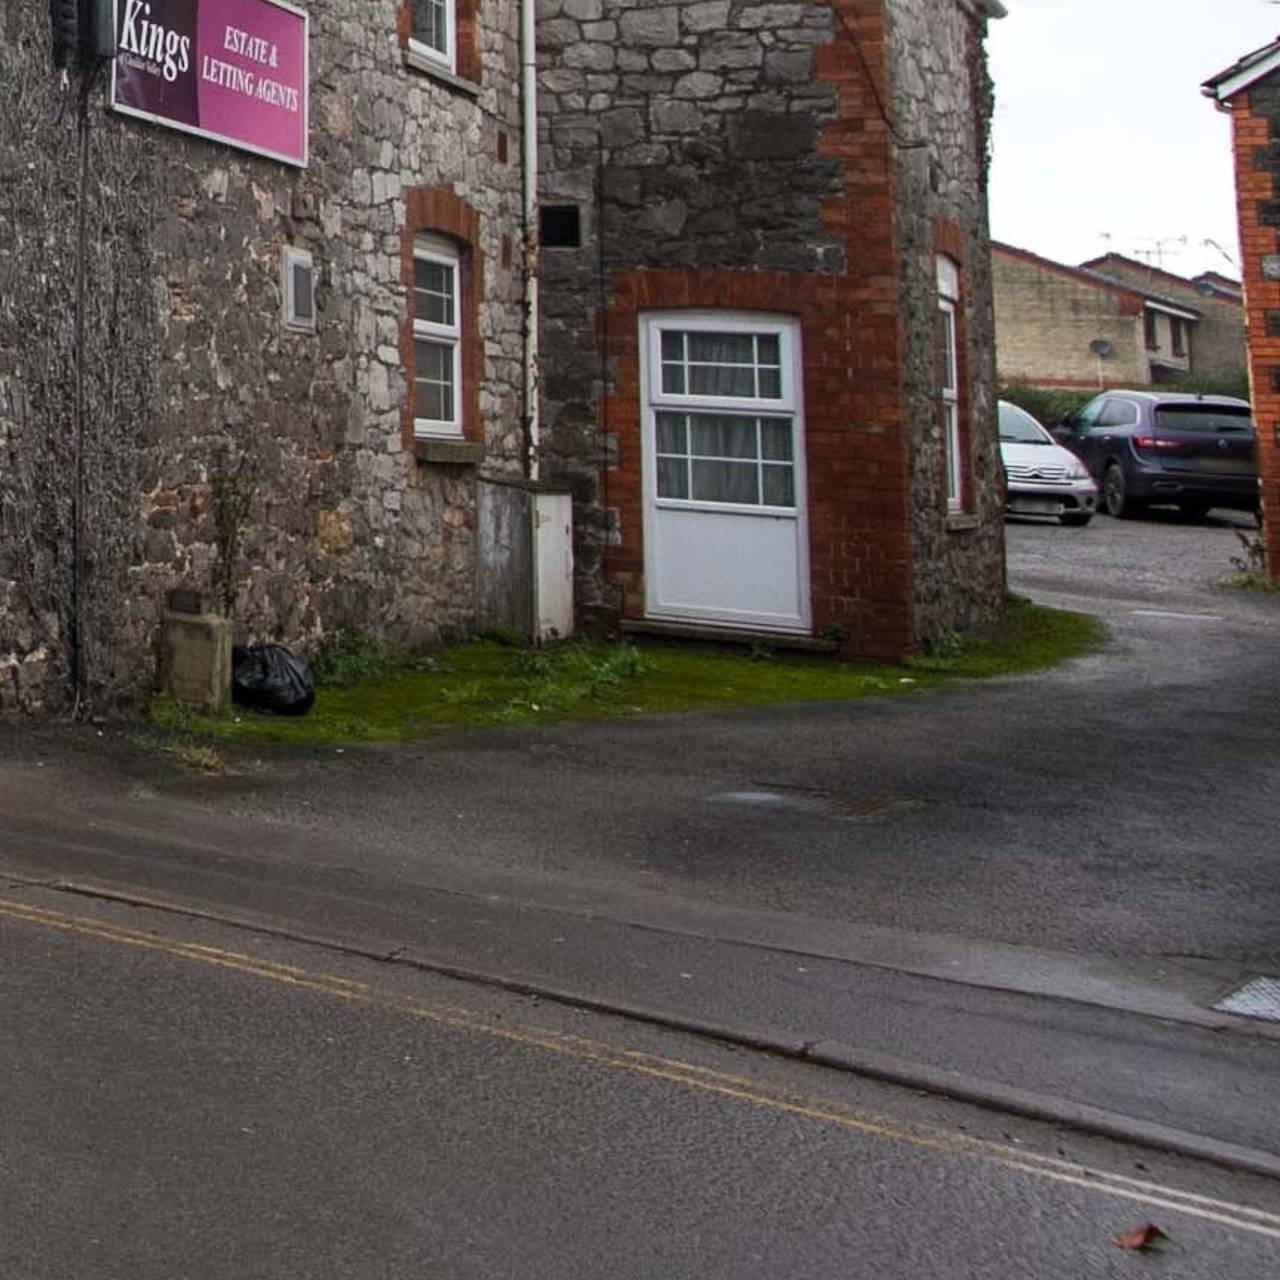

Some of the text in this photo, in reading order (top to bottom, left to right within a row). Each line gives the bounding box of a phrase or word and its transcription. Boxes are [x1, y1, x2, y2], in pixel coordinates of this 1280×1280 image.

[223, 25, 278, 68] ESTATE &
[202, 55, 299, 112] LETTING AGENTS
